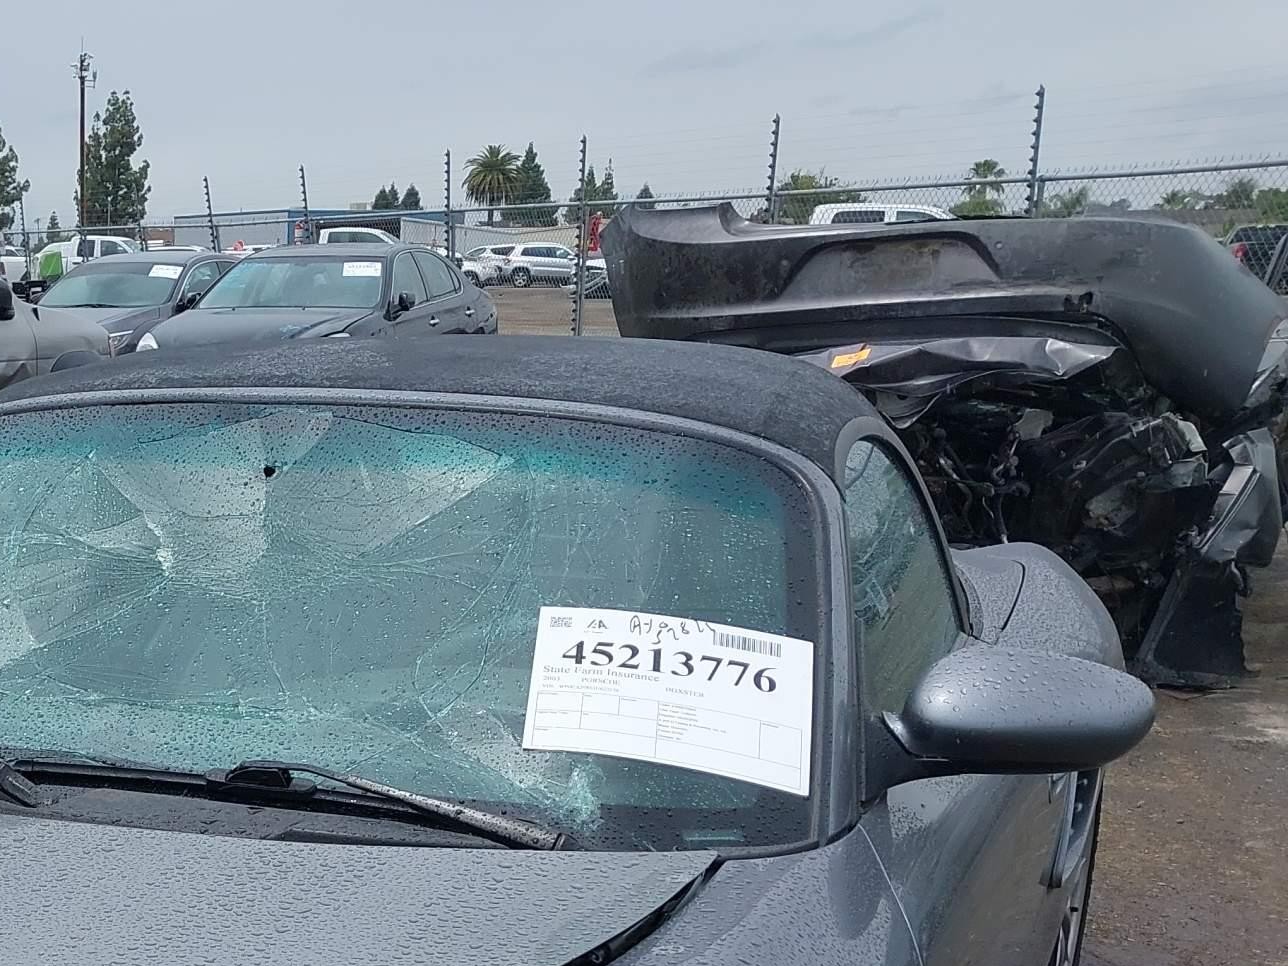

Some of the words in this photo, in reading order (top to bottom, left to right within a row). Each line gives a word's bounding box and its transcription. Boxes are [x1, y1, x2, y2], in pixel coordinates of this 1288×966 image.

[543, 665, 571, 674] State
[574, 666, 603, 676] Farm
[608, 669, 660, 682] Insurance
[562, 640, 777, 693] 45213776
